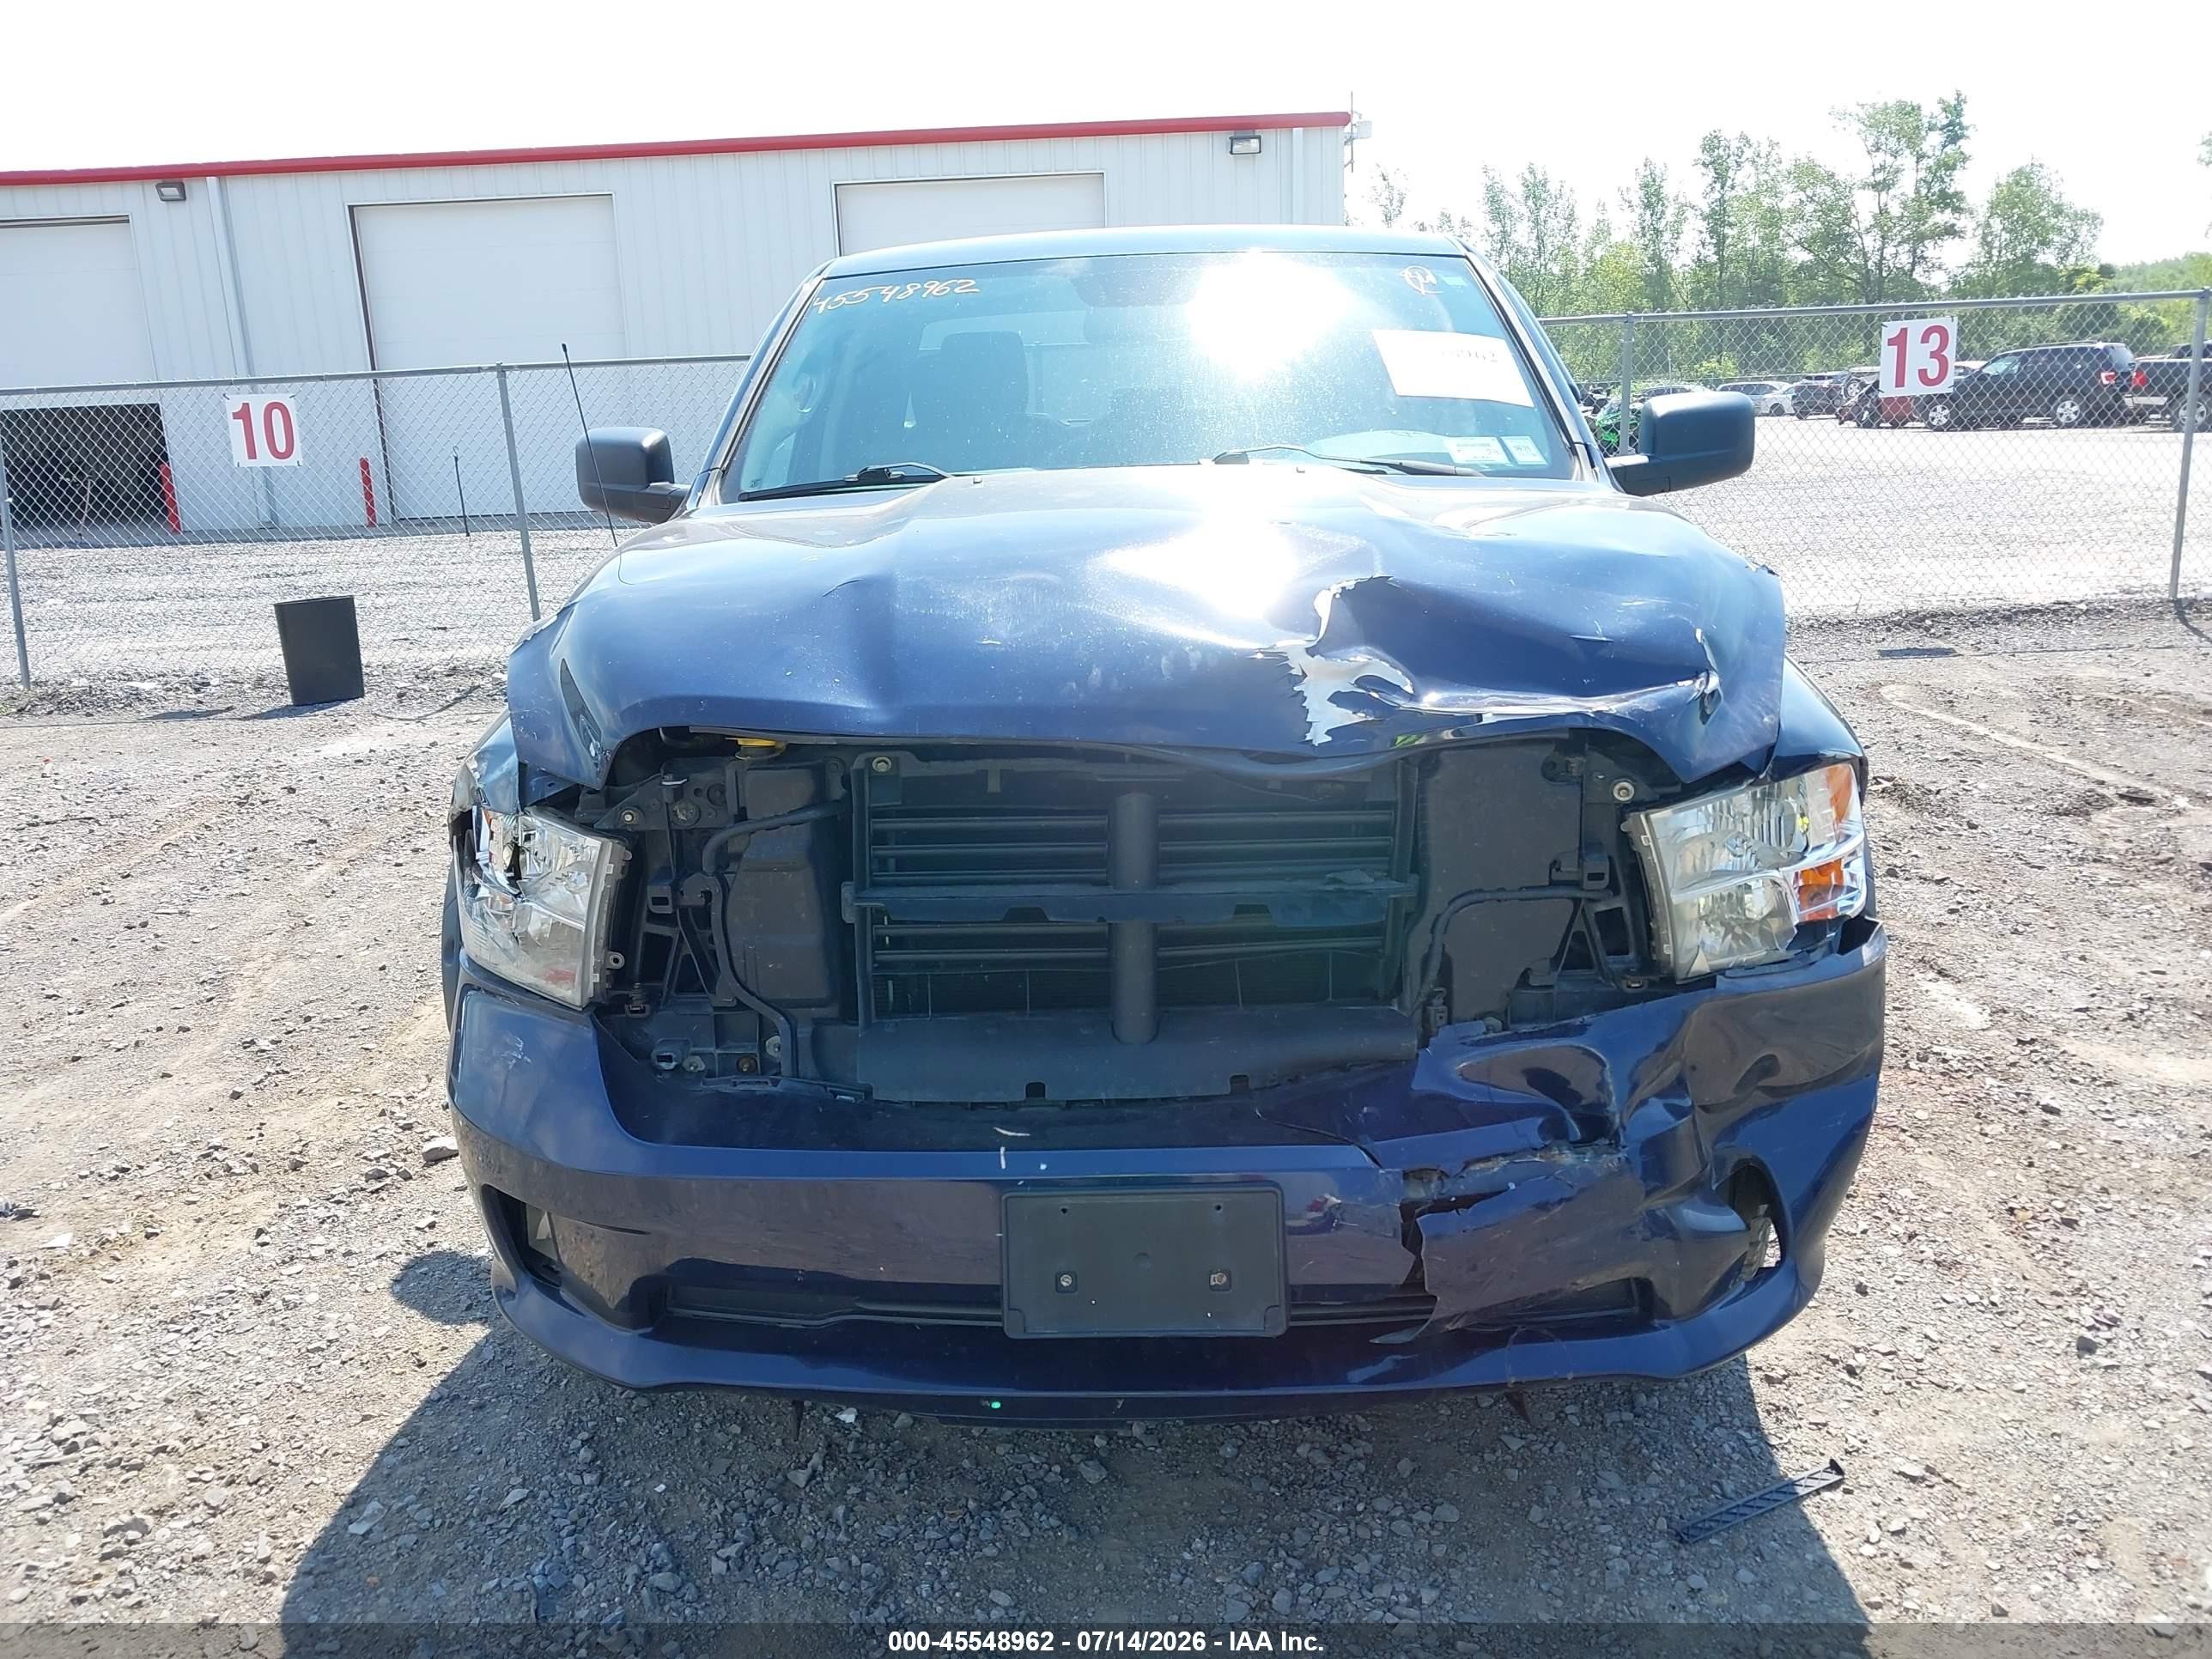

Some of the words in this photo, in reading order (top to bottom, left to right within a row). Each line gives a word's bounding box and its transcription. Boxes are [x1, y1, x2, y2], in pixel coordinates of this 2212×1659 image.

[813, 279, 981, 314] 45548962
[1887, 325, 1949, 388] 13
[232, 401, 295, 459] 10
